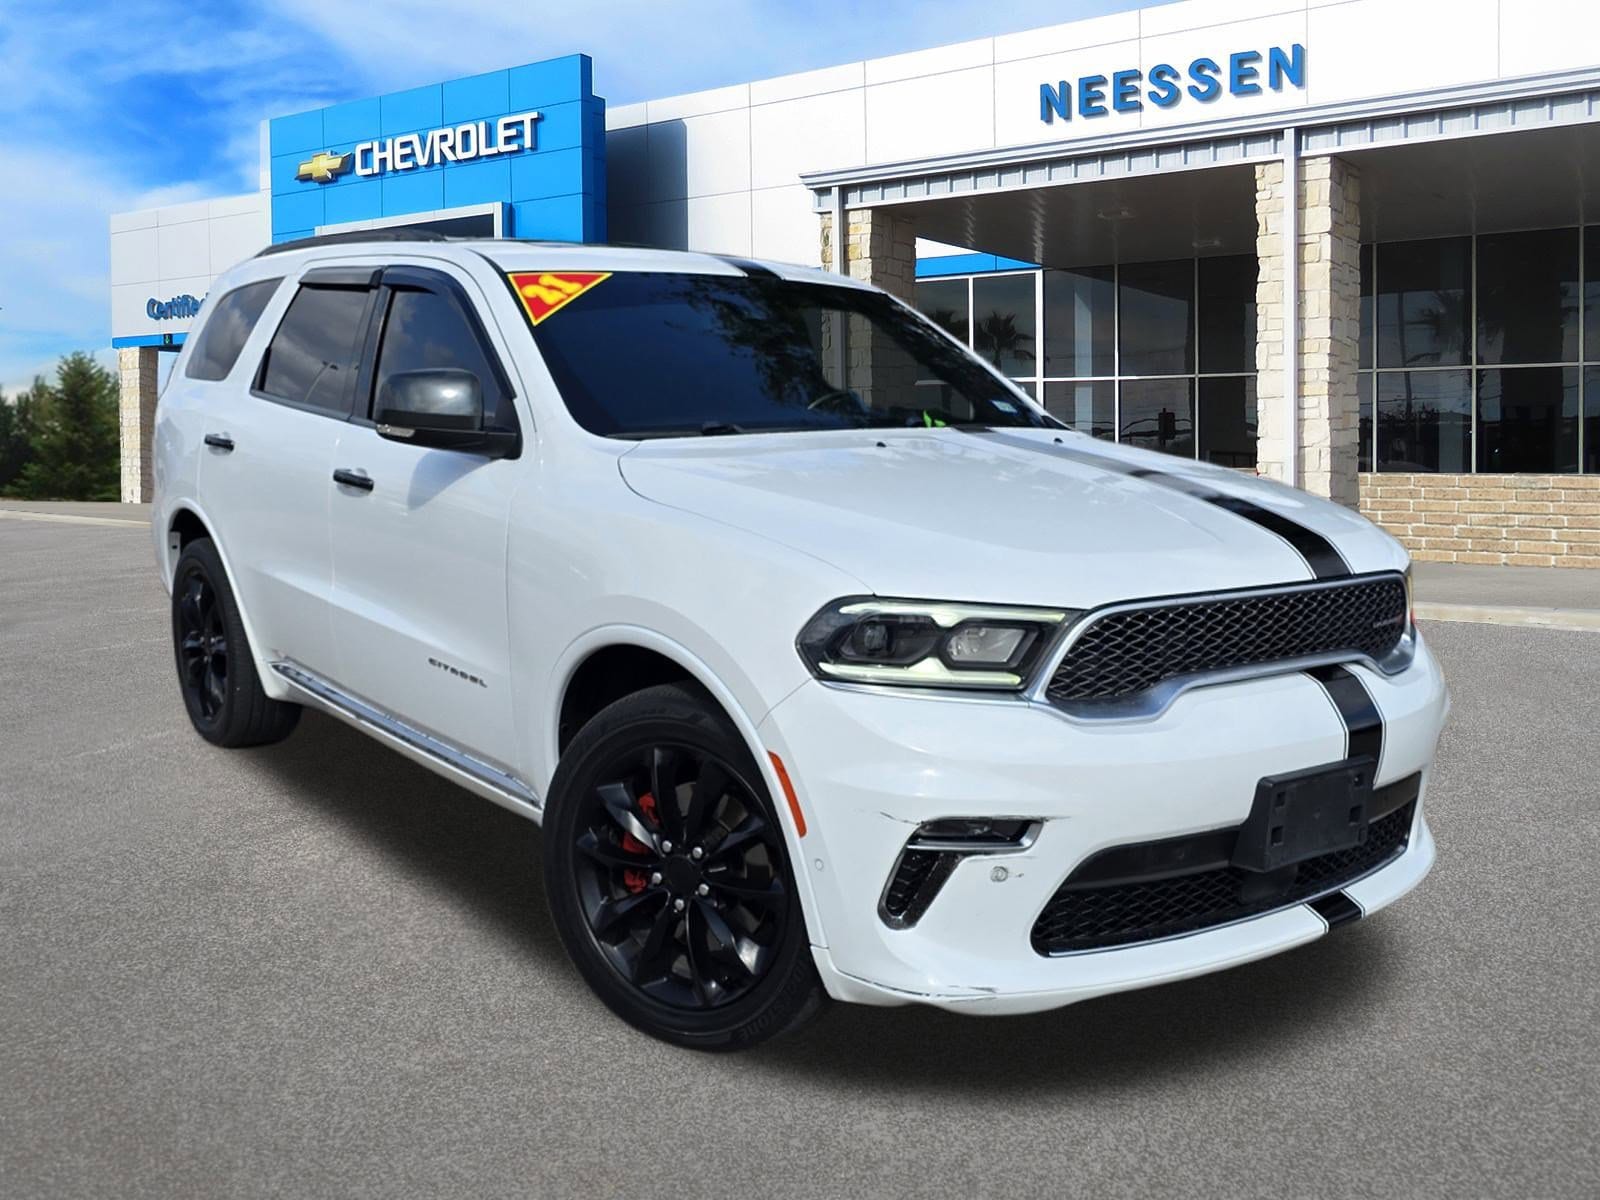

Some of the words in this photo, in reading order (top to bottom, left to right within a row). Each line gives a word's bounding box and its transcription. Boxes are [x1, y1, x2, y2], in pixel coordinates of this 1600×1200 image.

[1040, 44, 1305, 124] NEESSEN
[355, 111, 541, 176] CHEVROLET
[146, 292, 208, 320] Certifie
[428, 657, 488, 688] CITADEL
